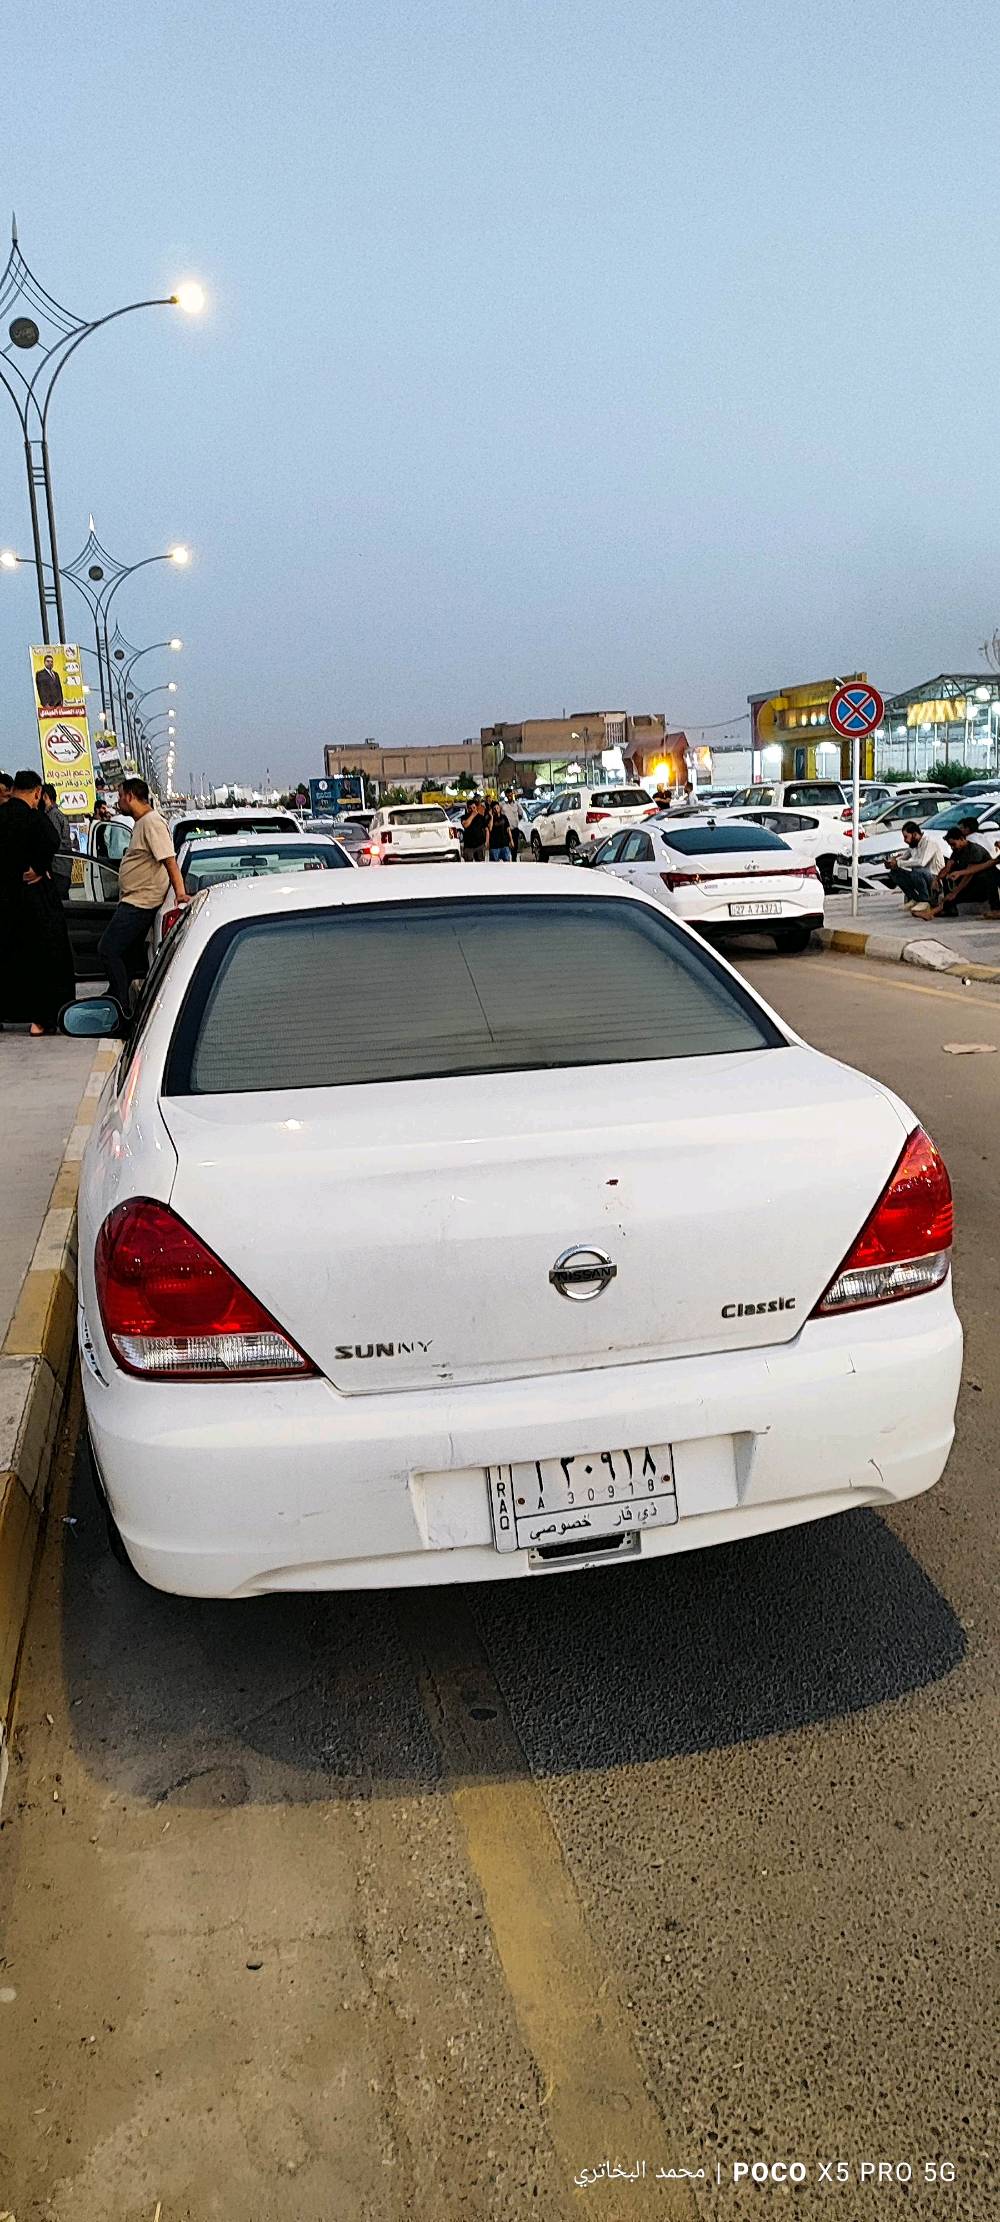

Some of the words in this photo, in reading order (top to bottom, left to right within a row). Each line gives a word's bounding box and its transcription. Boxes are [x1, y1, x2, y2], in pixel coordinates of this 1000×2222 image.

[554, 1266, 611, 1281] NISSAN
[721, 1296, 796, 1319] Classic
[334, 1339, 433, 1360] SUNNY
[537, 1496, 546, 1510] A
[612, 1505, 633, 1526] قار
